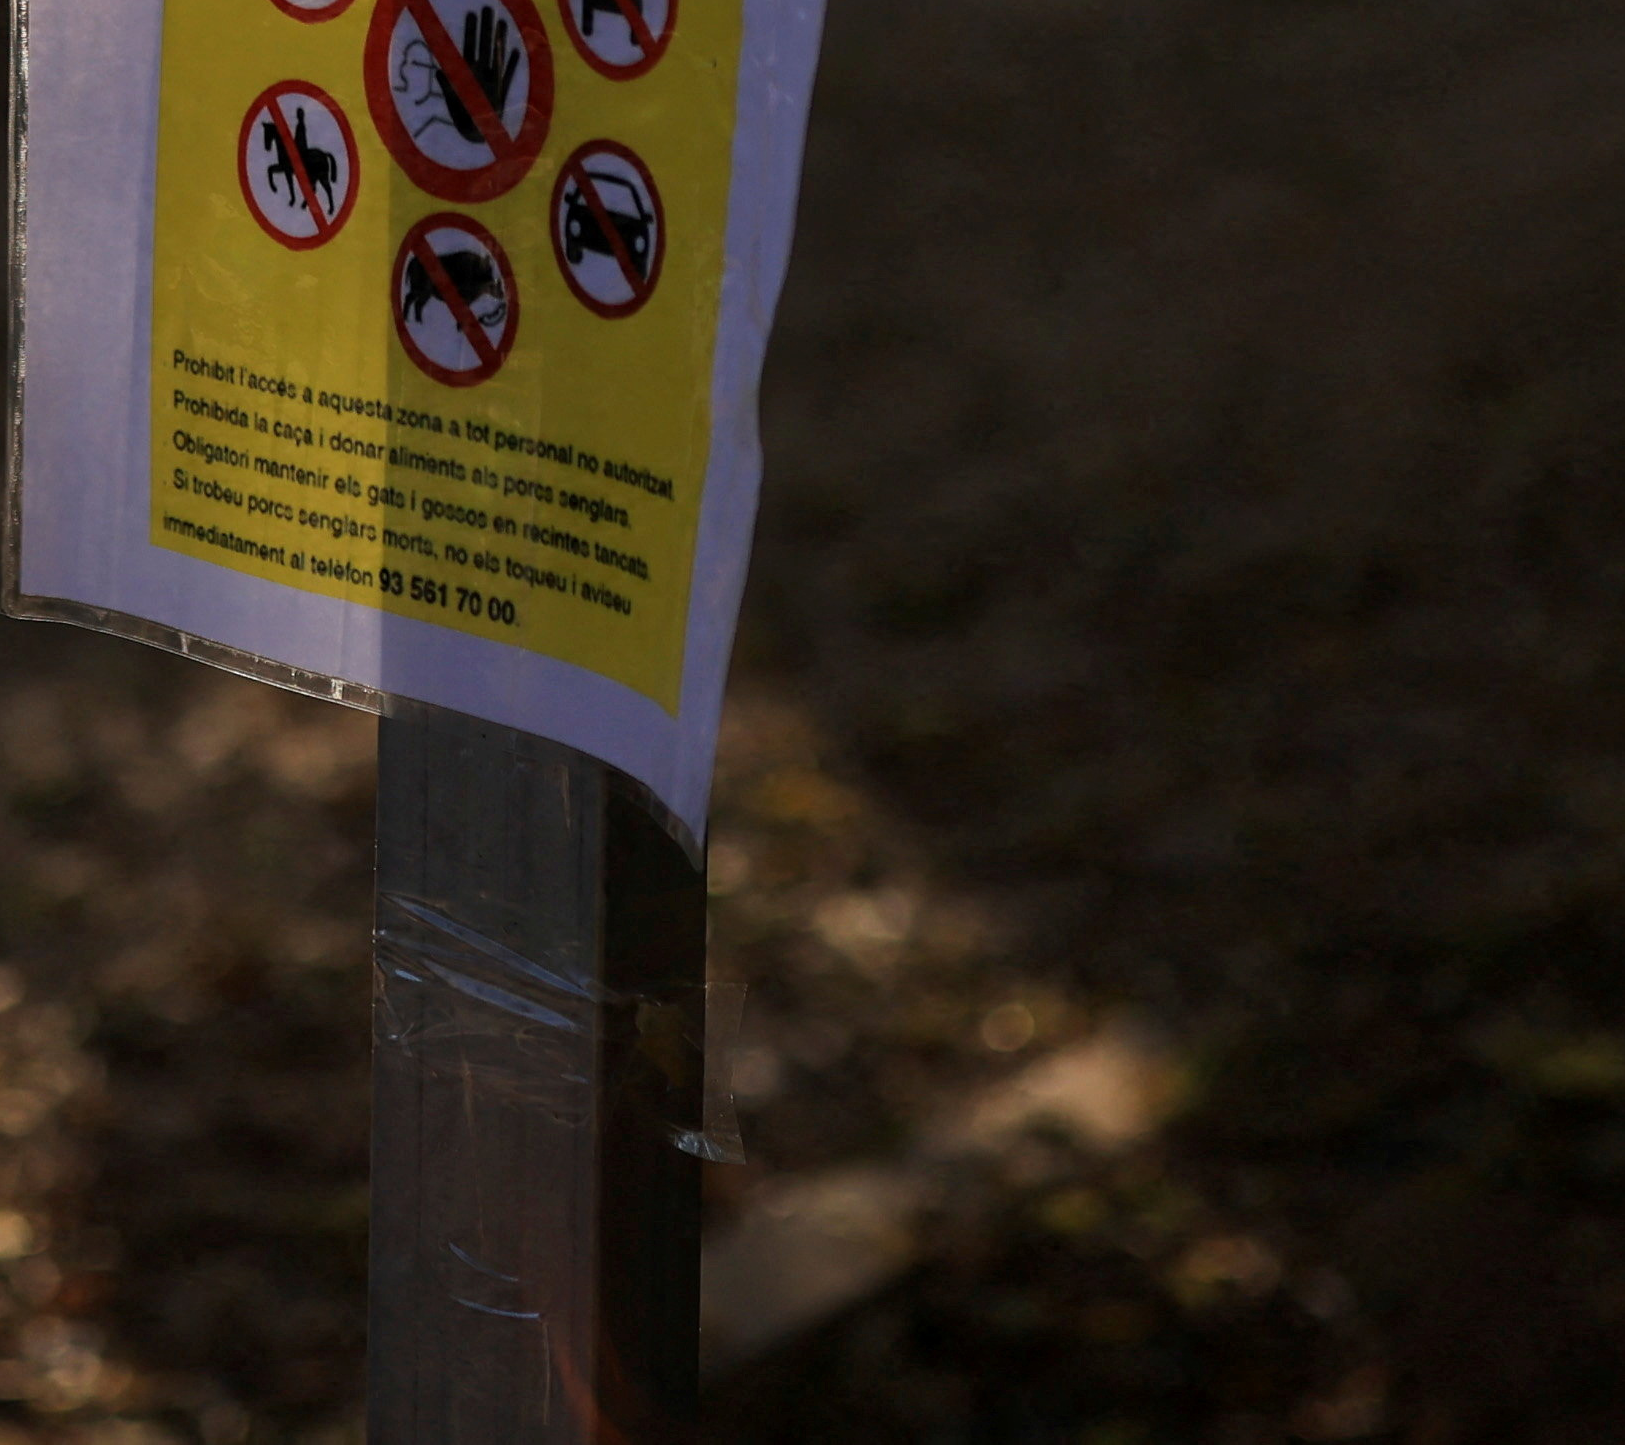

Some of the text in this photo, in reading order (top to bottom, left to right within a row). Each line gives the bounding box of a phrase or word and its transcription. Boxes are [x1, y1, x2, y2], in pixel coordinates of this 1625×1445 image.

[173, 349, 234, 385] Prohibit
[302, 386, 313, 404] a
[318, 390, 392, 422] aquesta
[397, 408, 442, 434] zona
[449, 419, 460, 438] a
[466, 420, 490, 445] tot
[495, 430, 573, 466] personal
[577, 452, 599, 474] no
[173, 389, 249, 428] Prohibida
[254, 412, 268, 433] la
[273, 421, 313, 447] caça
[320, 427, 324, 447] i
[329, 431, 385, 460] donar
[389, 446, 466, 482] aliments
[471, 465, 499, 489] als
[504, 474, 554, 503] porcs
[173, 430, 249, 469] Obligatori
[254, 456, 329, 489] mantenir
[335, 474, 361, 498] els
[367, 484, 405, 510] gats
[411, 489, 415, 510] i
[421, 497, 488, 530] gossos
[493, 514, 517, 536] en
[522, 522, 590, 558] recintes
[173, 468, 631, 616] Si trobeu porcs senglars morts, no els toqueu i aviseu
[163, 510, 285, 566] immediatament
[290, 550, 305, 571] al
[310, 555, 374, 588] telèfon
[379, 567, 404, 596] 93
[410, 574, 448, 608] 561
[456, 586, 482, 617] 70
